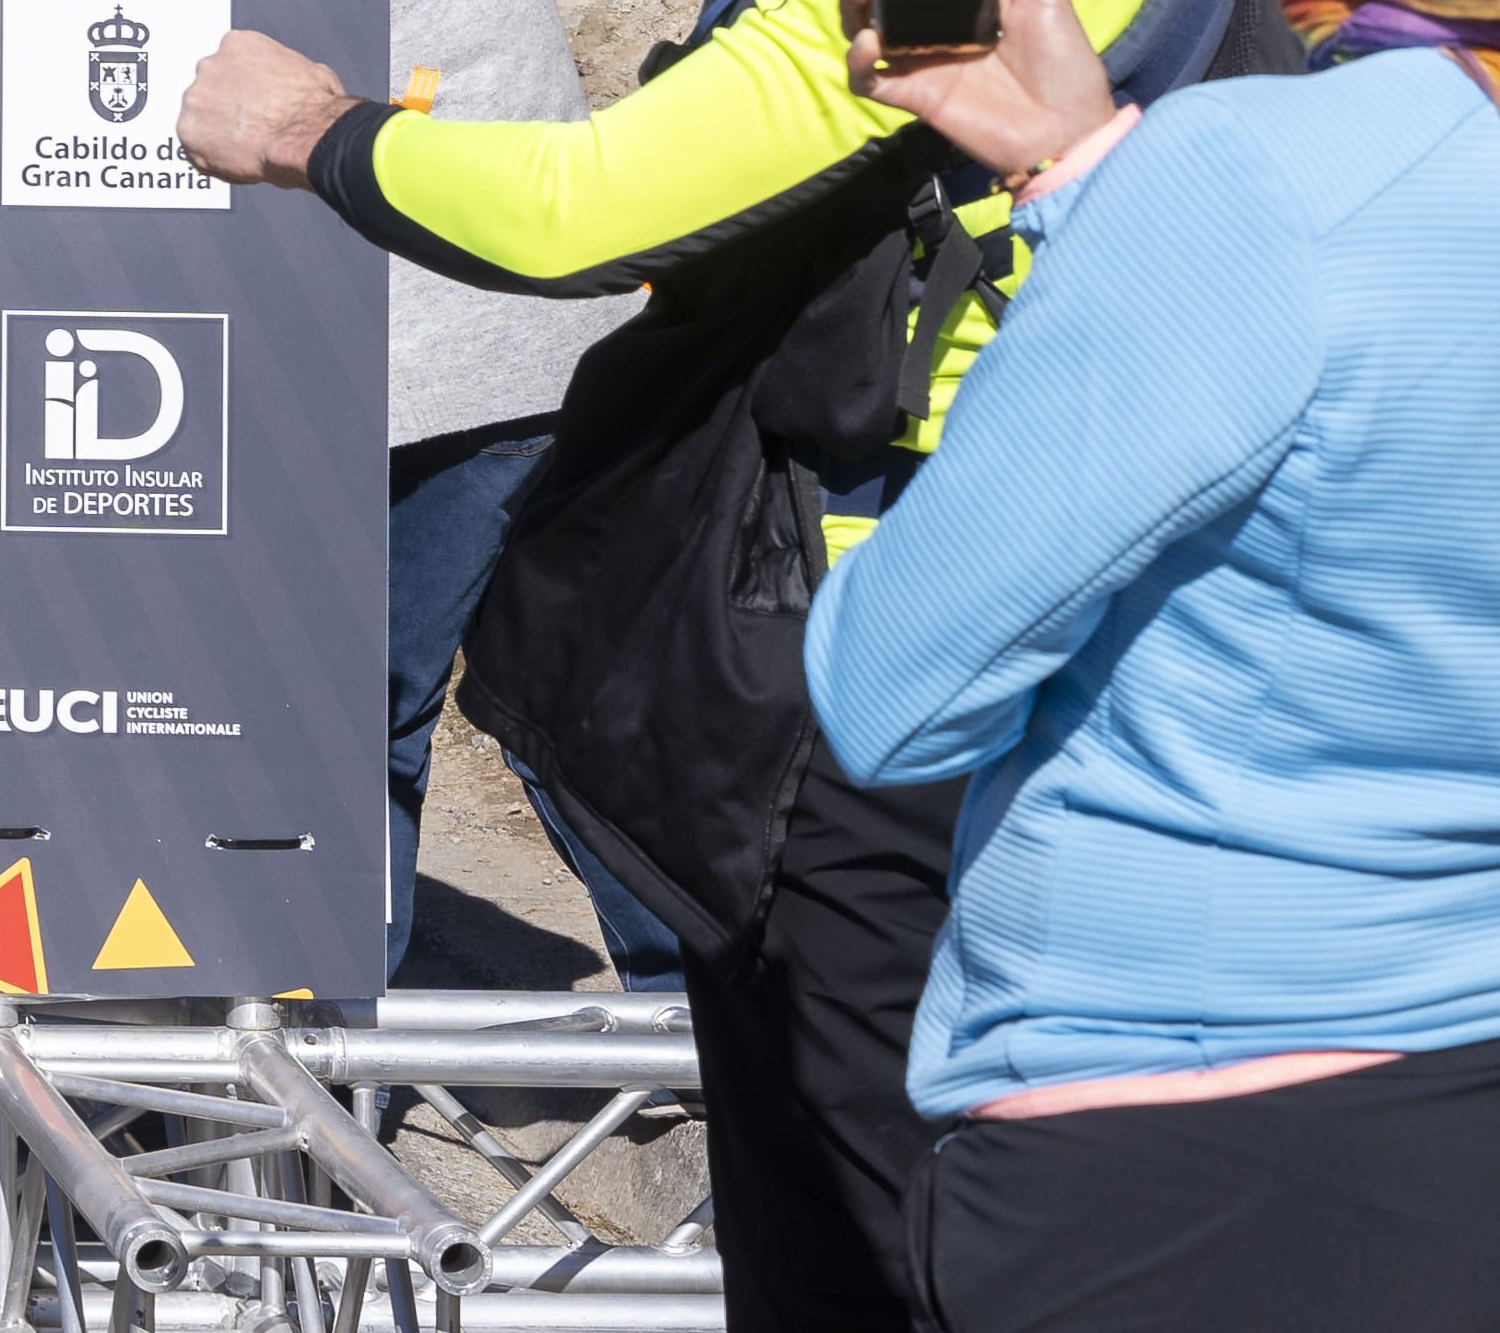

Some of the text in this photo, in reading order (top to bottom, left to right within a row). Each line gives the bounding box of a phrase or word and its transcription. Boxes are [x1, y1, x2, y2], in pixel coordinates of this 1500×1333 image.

[34, 135, 149, 162] Cabildo
[20, 164, 212, 191] Gran Canaria
[24, 462, 203, 489] INSTITUTO INSULAR
[33, 492, 194, 518] DE DEPORTES
[126, 691, 173, 704] UNION
[126, 707, 188, 720] CYCLISTE
[126, 722, 241, 736] INTERNATIONALE
